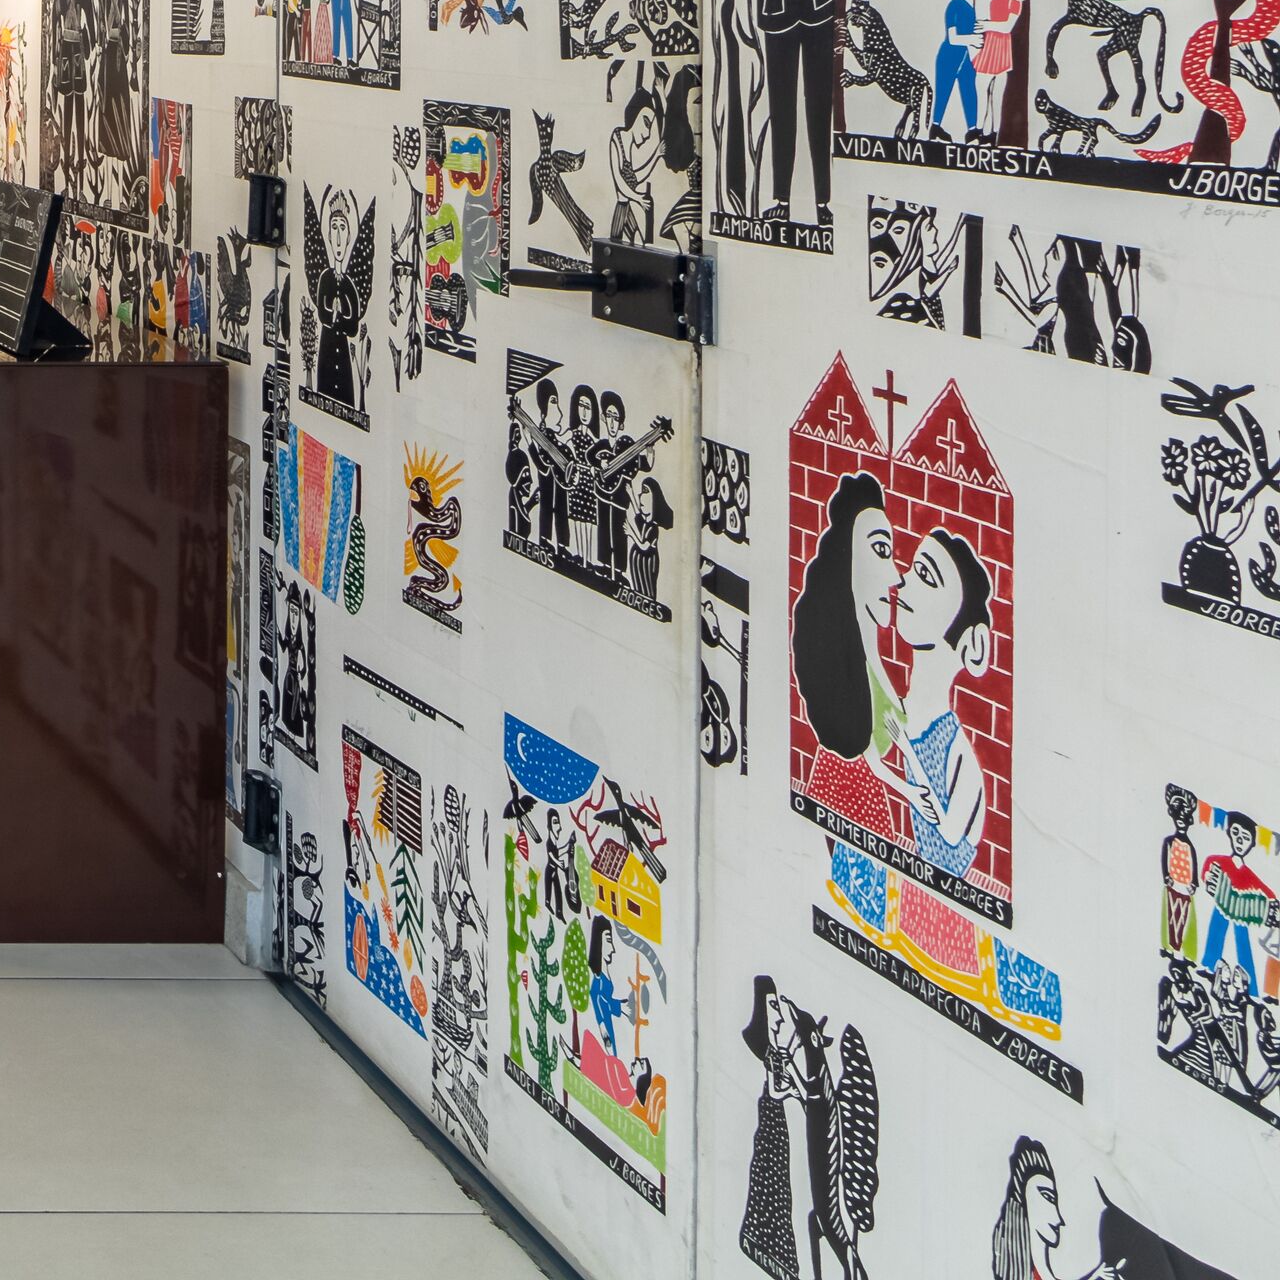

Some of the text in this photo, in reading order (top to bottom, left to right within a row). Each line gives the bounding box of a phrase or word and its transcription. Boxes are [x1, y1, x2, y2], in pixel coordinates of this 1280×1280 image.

[838, 136, 1280, 203] VIDA NA FLORESTA J.BORGE
[501, 118, 511, 295] NA CANTORIA J.BORGES
[712, 218, 833, 252] LAMPIÃO E MAR
[505, 536, 555, 569] VIOLEIROS
[1200, 602, 1280, 639] J.BORGE
[794, 796, 1004, 921] O PRIMEIRO AMOR J.BORGES
[828, 920, 898, 979] SENHORA
[902, 969, 981, 1033] APARECIDA
[506, 1060, 536, 1096] ANDEI
[541, 1092, 560, 1118] POR
[743, 1238, 751, 1254] A
